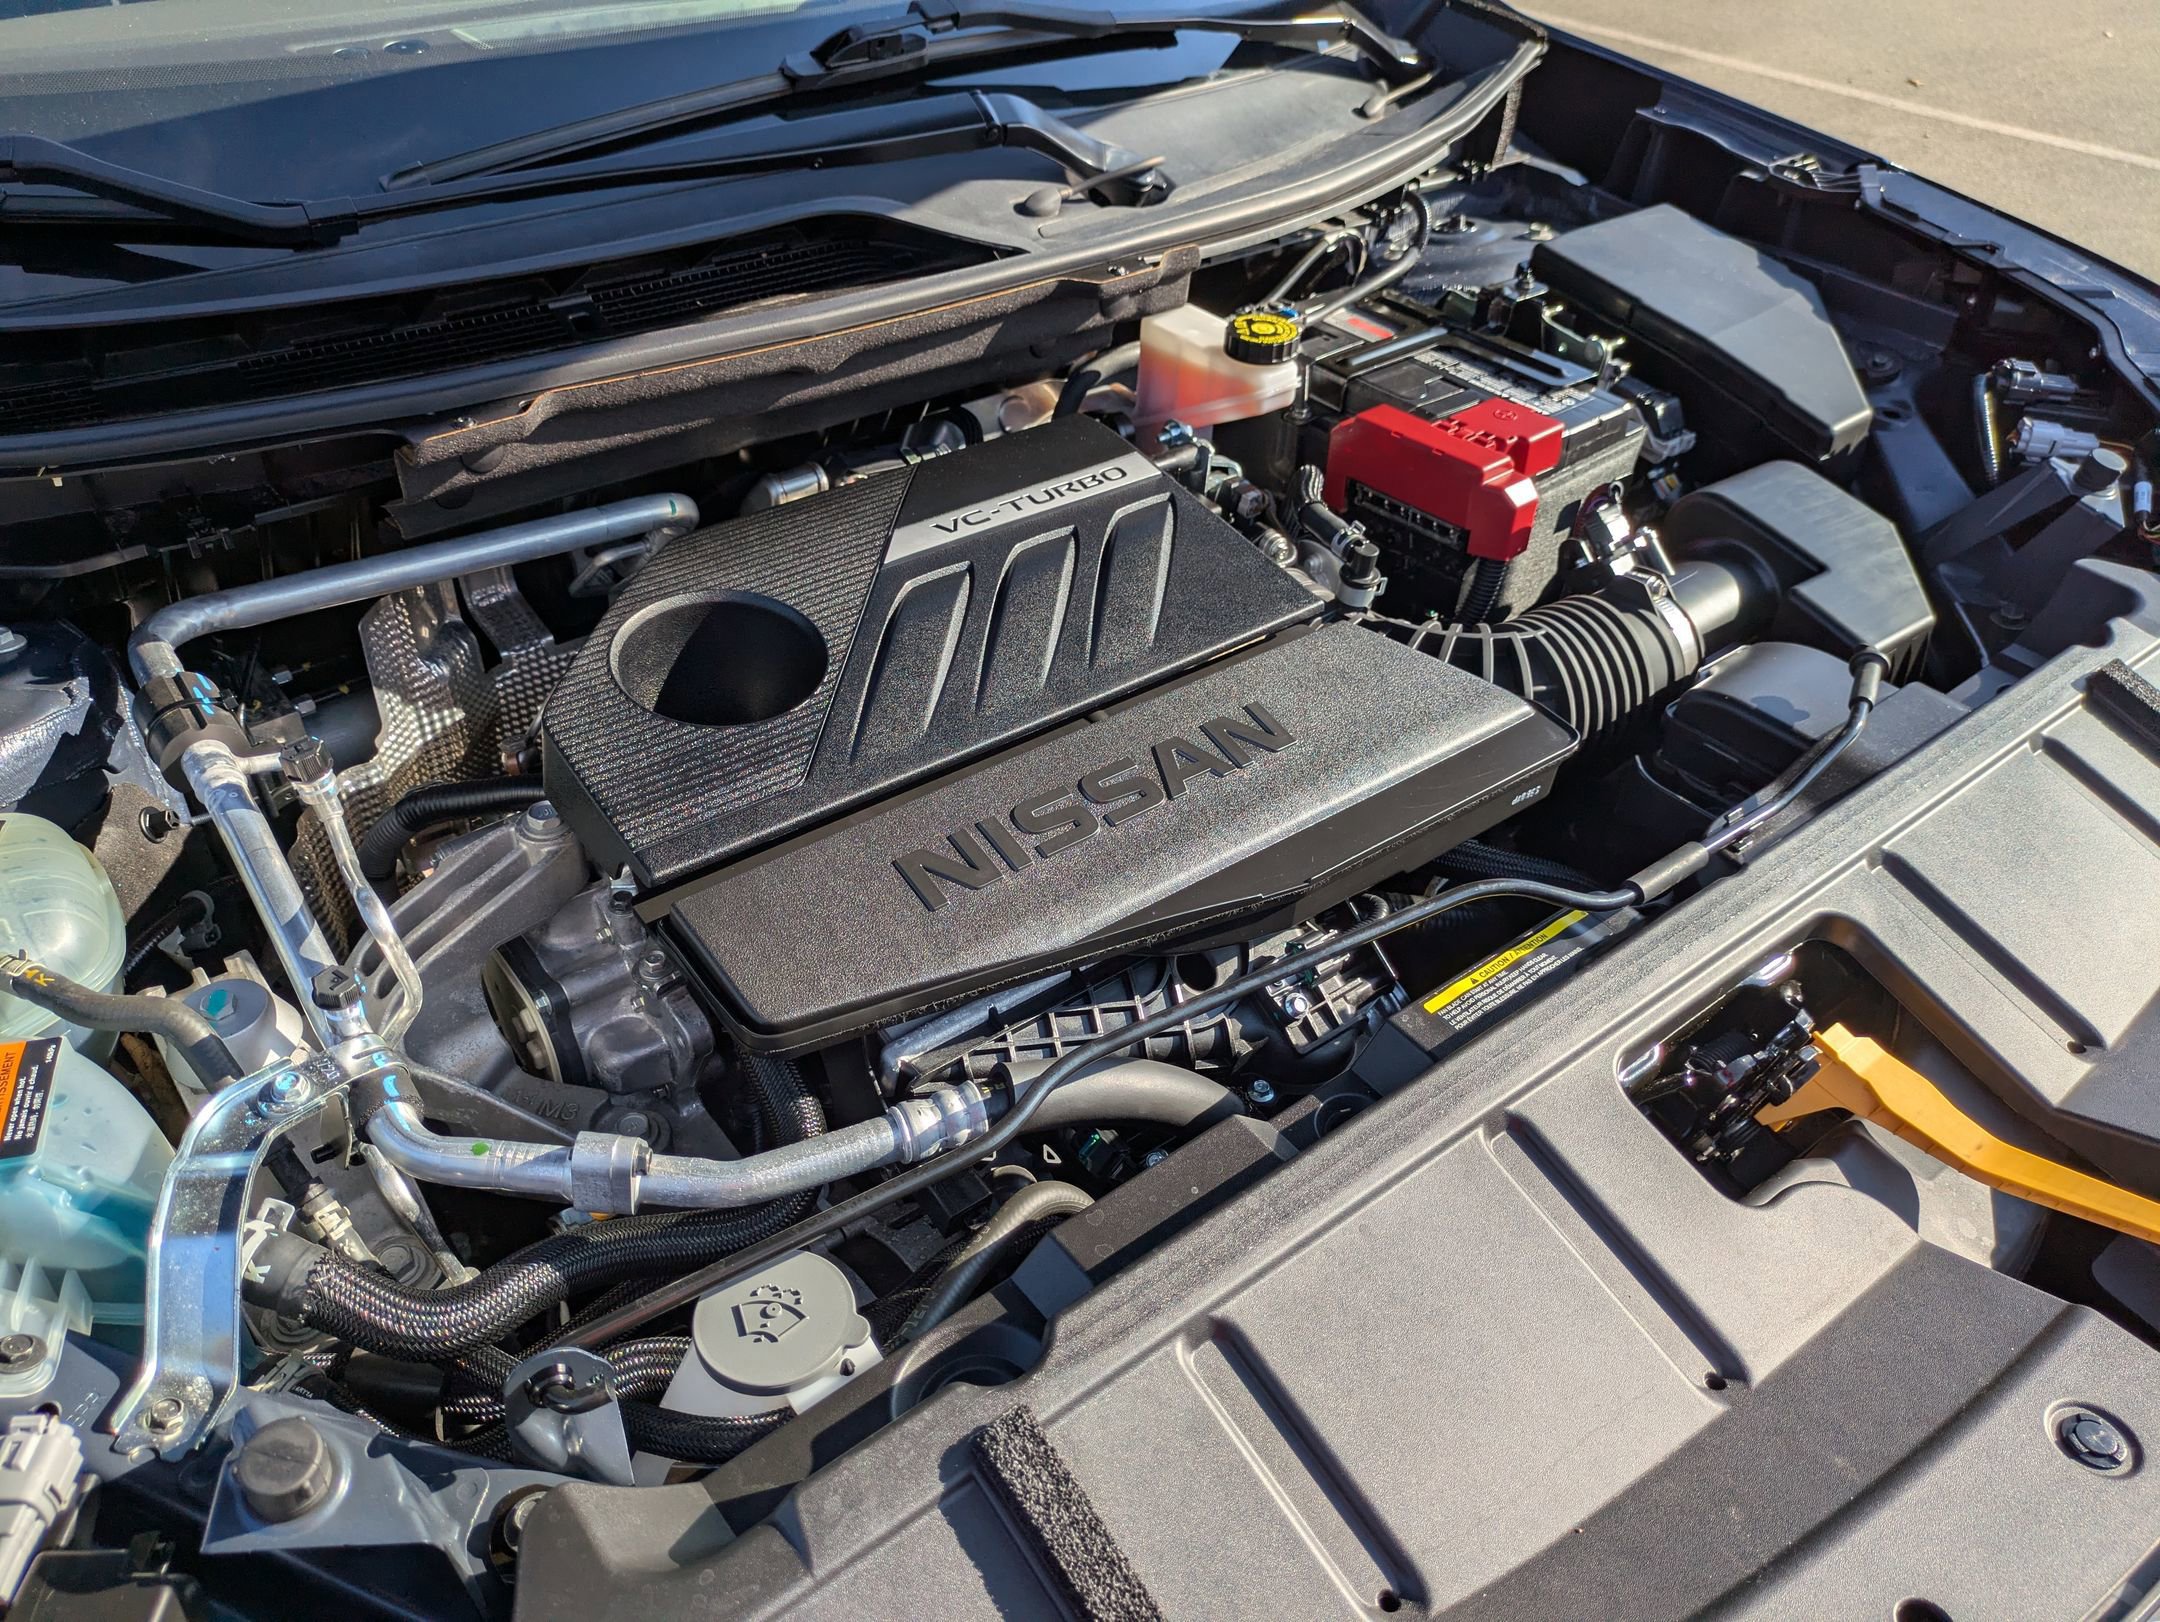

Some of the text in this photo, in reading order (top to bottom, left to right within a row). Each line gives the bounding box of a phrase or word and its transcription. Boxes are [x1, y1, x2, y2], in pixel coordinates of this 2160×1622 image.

[929, 466, 1128, 533] VC-TURBO
[892, 701, 1298, 912] NISSAN
[1479, 955, 1510, 978] CAUTION
[1514, 934, 1548, 955] ATTENTION
[1449, 1006, 1462, 1016] HELP
[1460, 998, 1476, 1008] AVOID
[1474, 985, 1497, 1000] PERSONAL
[1454, 1002, 1484, 1021] VENTILATEUR
[1454, 1020, 1469, 1030] POUR
[0, 1052, 16, 1112] SSEMENT
[3, 1076, 26, 1141] Never open when hot.
[23, 1091, 33, 1108] ouvrir
[17, 1108, 29, 1130] jamais
[14, 1130, 24, 1140] Ne
